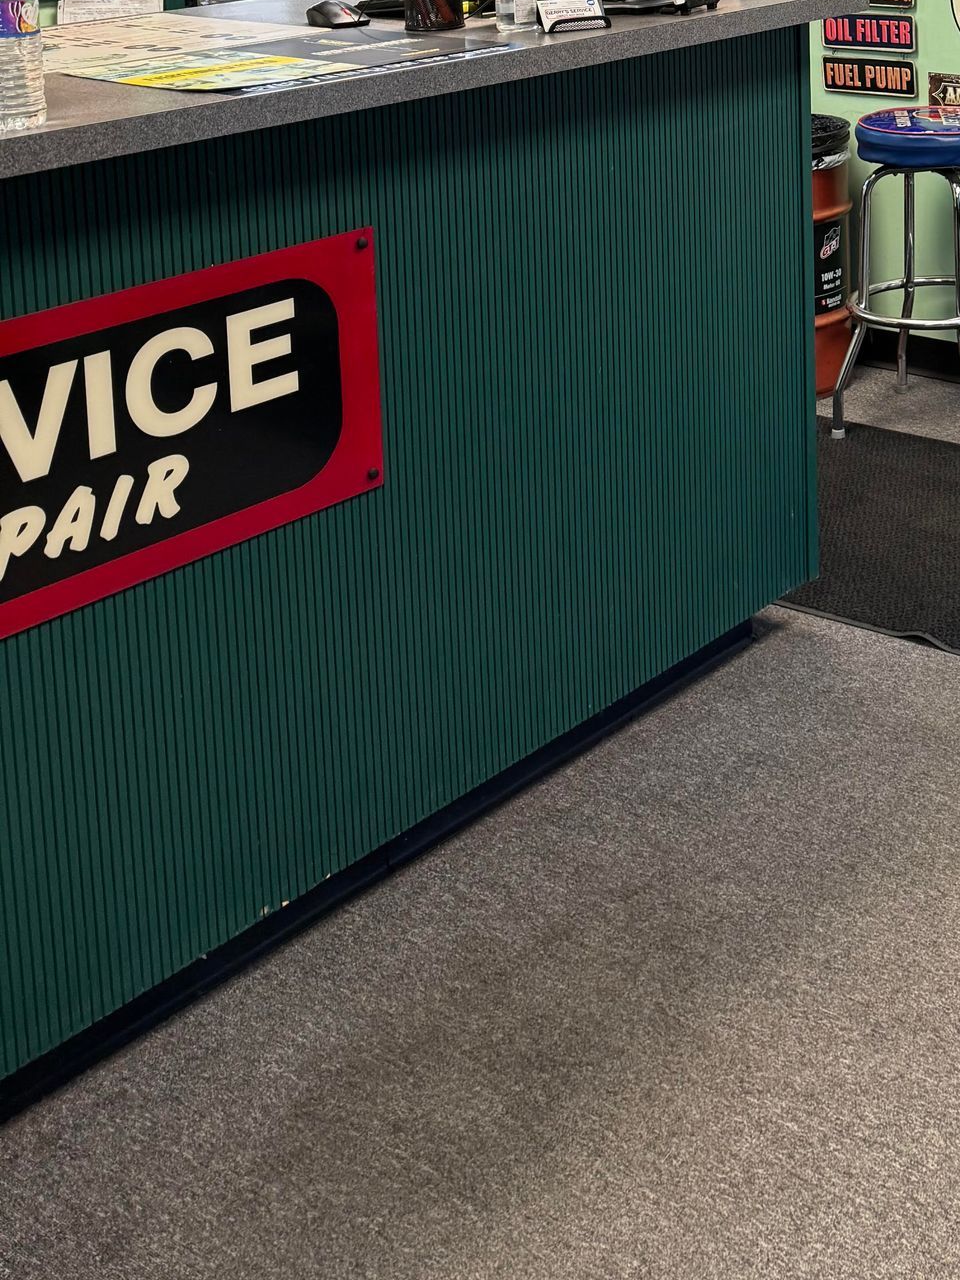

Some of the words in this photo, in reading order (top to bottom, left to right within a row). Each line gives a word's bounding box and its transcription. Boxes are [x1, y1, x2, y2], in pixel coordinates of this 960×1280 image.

[825, 18, 852, 42] OIL
[856, 19, 911, 45] FILTER
[826, 62, 861, 87] FUEL
[864, 65, 912, 90] PUMP
[821, 268, 842, 283] 10W-30
